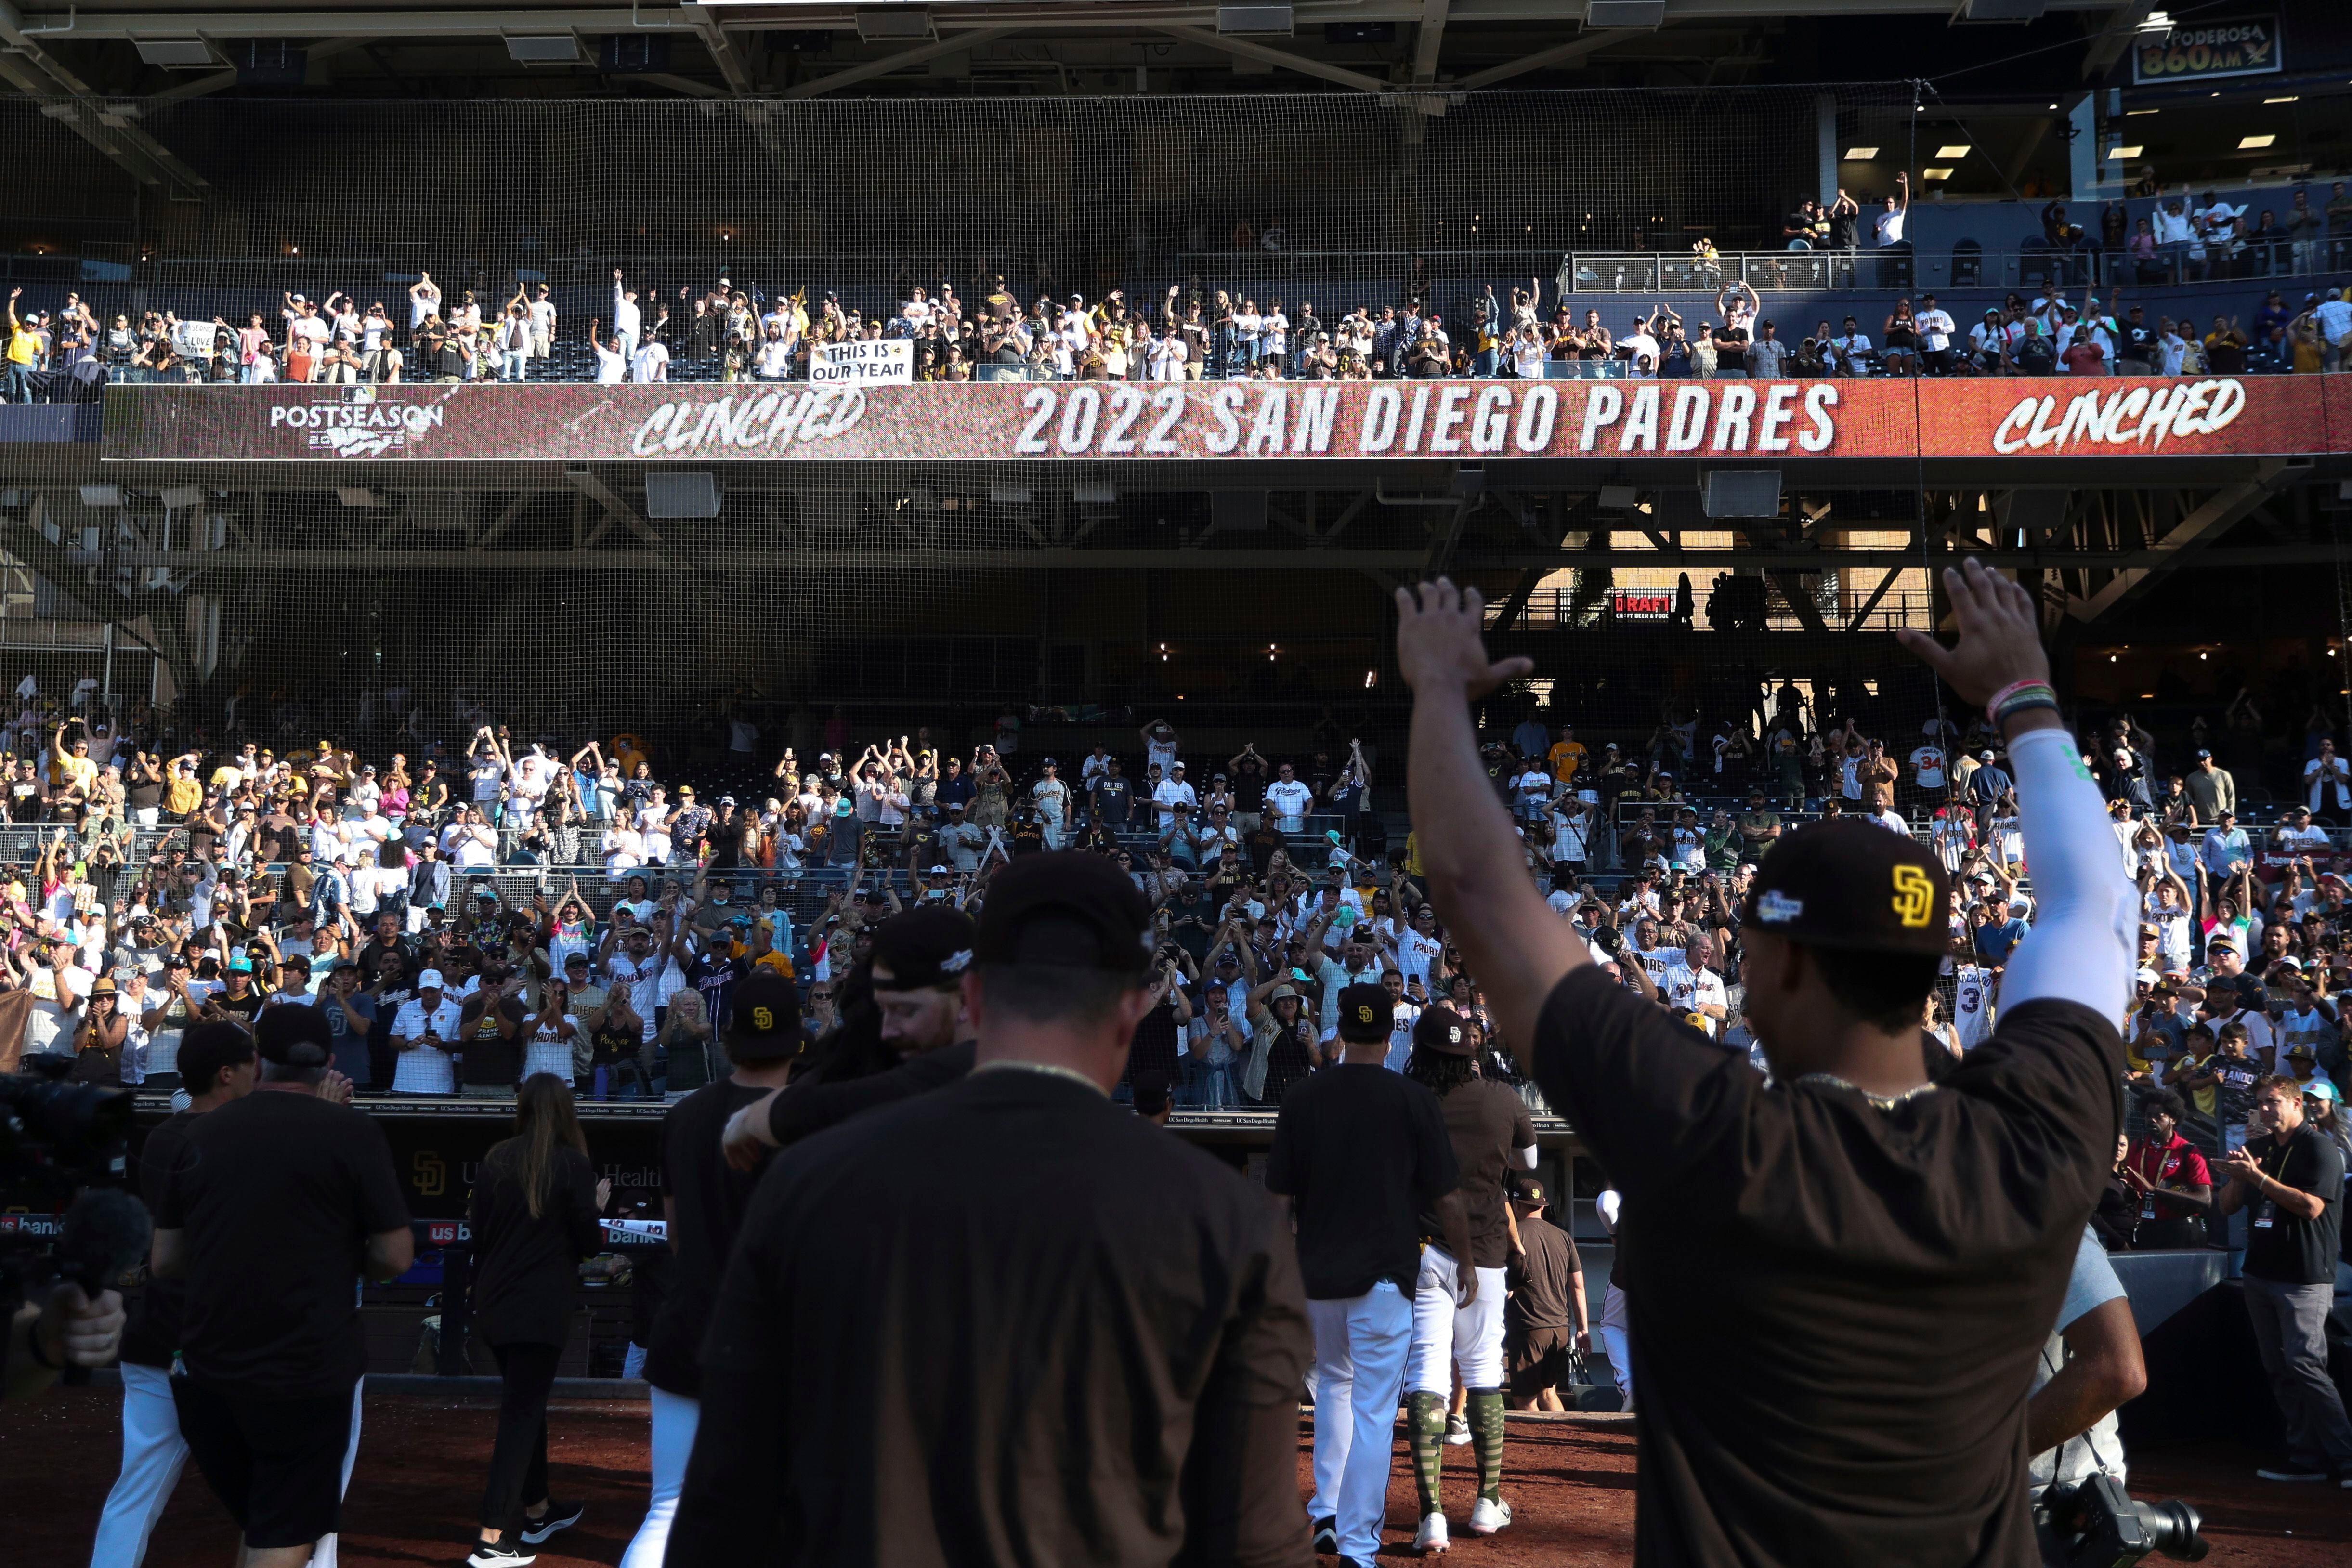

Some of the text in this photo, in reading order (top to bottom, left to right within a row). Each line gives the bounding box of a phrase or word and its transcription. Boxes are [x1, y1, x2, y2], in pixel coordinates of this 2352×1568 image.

[2171, 24, 2266, 46] PODEROSA
[1921, 317, 1944, 326] PADRES
[183, 336, 211, 346] I LOVE
[828, 343, 889, 362] THIS IS
[813, 363, 904, 381] OUR YEAR
[271, 405, 443, 429] POSTSEASON
[632, 387, 867, 457] CLINCHED
[1014, 384, 1839, 453] 2022 SAN DIEGO PADRES
[1993, 378, 2246, 455] CLINCHED
[1153, 745, 1172, 754] PADRES
[1920, 755, 1941, 771] 34
[1275, 786, 1300, 796] Padres
[1015, 831, 1041, 839] padres
[1892, 864, 1935, 927] SD
[699, 970, 735, 991] PADRES
[1961, 988, 1980, 1013] 3
[753, 1007, 773, 1030] SD
[1358, 1006, 1373, 1023] SD
[1449, 1026, 1461, 1043] SD
[413, 1150, 447, 1196] SD
[432, 1227, 453, 1240] us
